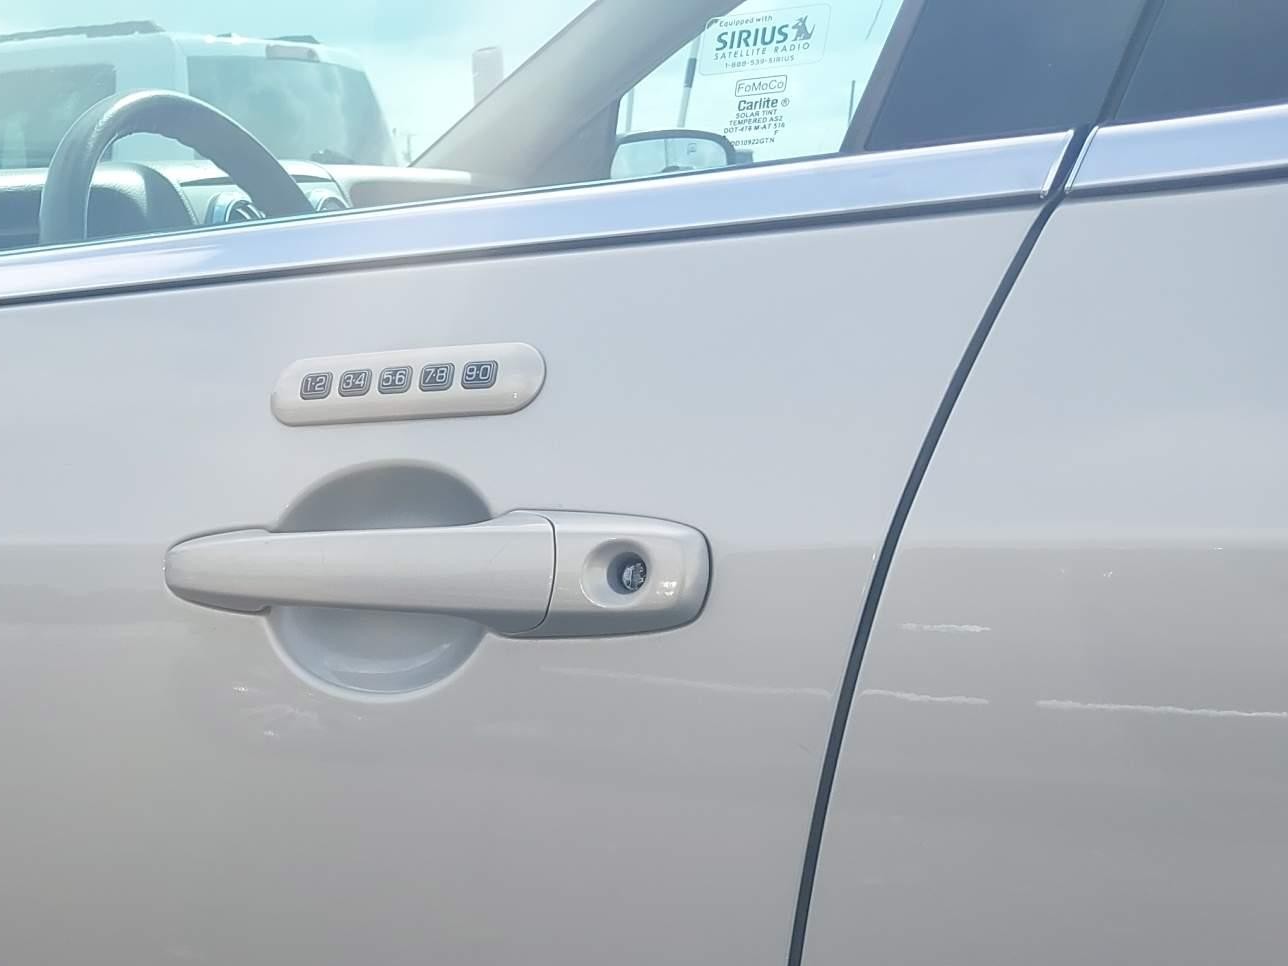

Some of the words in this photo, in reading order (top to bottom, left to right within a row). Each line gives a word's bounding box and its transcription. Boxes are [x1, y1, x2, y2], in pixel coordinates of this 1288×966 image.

[719, 17, 753, 28] Equipped
[755, 15, 773, 23] with
[715, 24, 789, 51] SIRIUS
[713, 47, 767, 60] SATELLITE
[774, 42, 810, 53] RADIO
[737, 79, 784, 94] FoMoCo
[729, 117, 768, 126] TEMPERED
[735, 111, 760, 119] SOLAR
